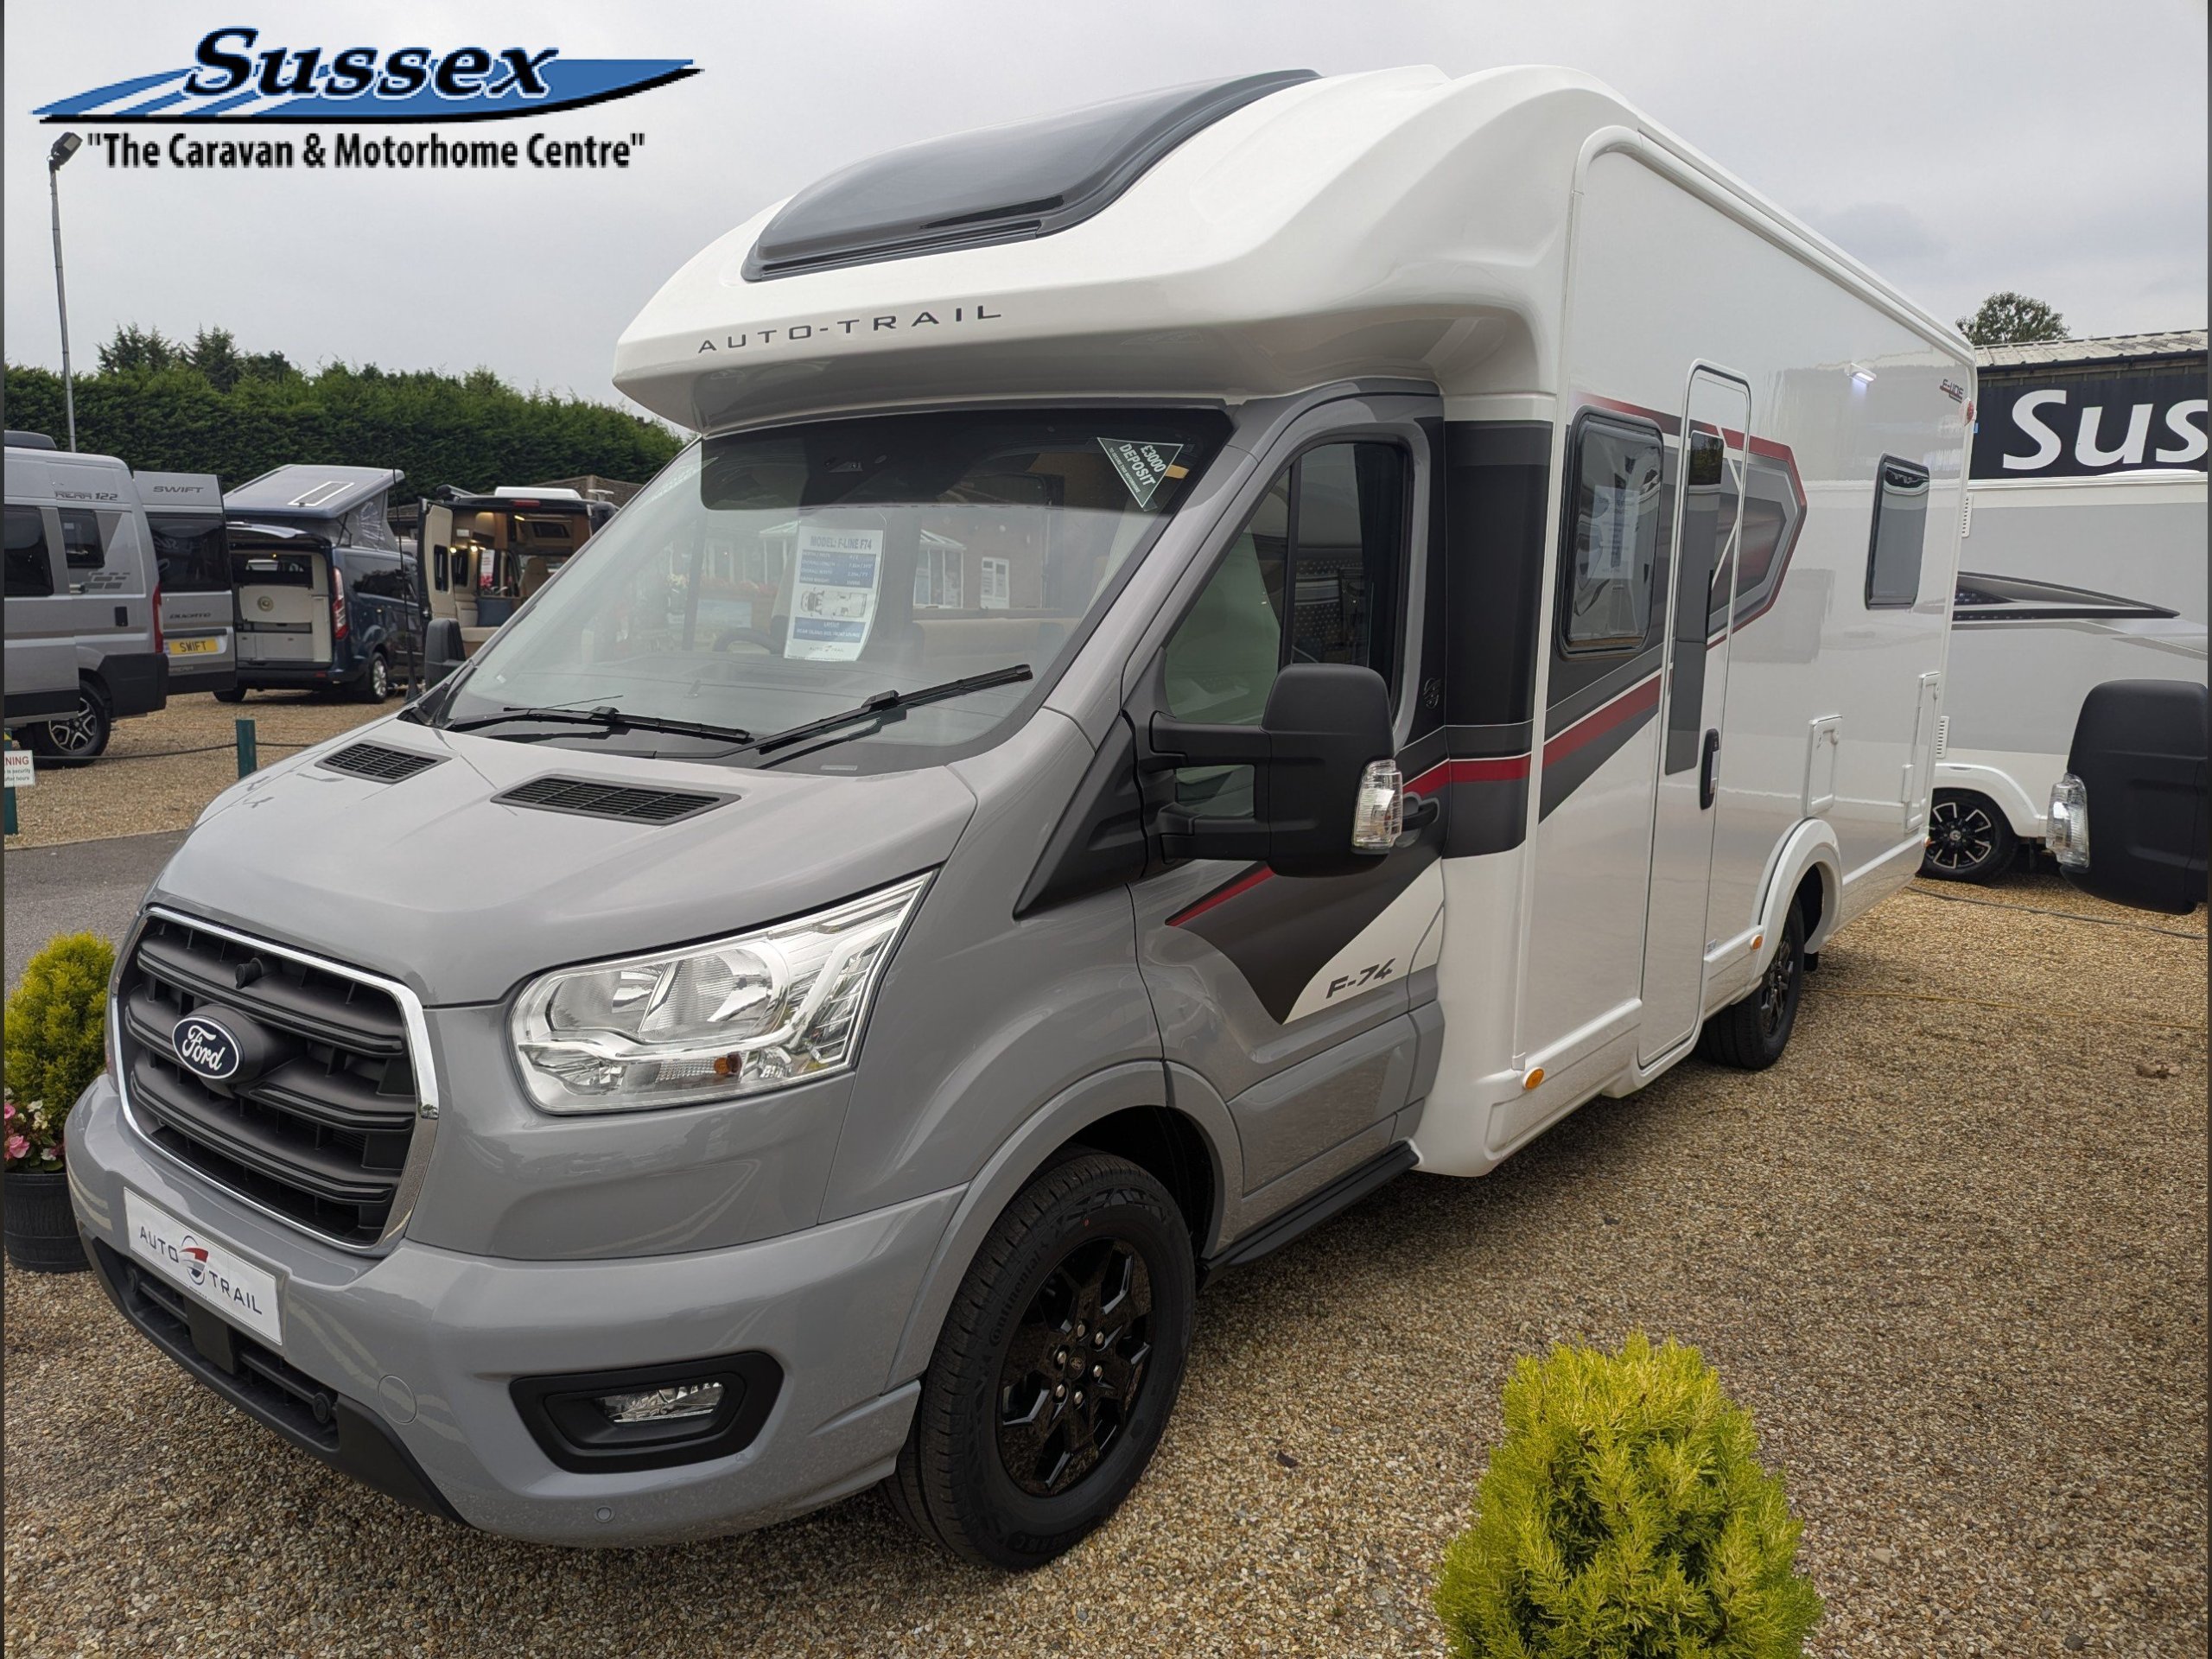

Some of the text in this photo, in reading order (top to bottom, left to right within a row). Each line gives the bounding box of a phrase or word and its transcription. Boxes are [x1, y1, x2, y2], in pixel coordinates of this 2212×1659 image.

[697, 305, 1001, 353] AUTO-TRAIL
[1119, 442, 1156, 486] DEPOSIT
[1140, 444, 1166, 473] £3000
[95, 492, 118, 501] 122
[810, 535, 872, 550] MODEL: F-LINE F74
[179, 640, 207, 653] SWIFT
[1325, 957, 1396, 999] F-74
[182, 1025, 226, 1071] Ford
[140, 1226, 263, 1315] AUTO TRAIL
